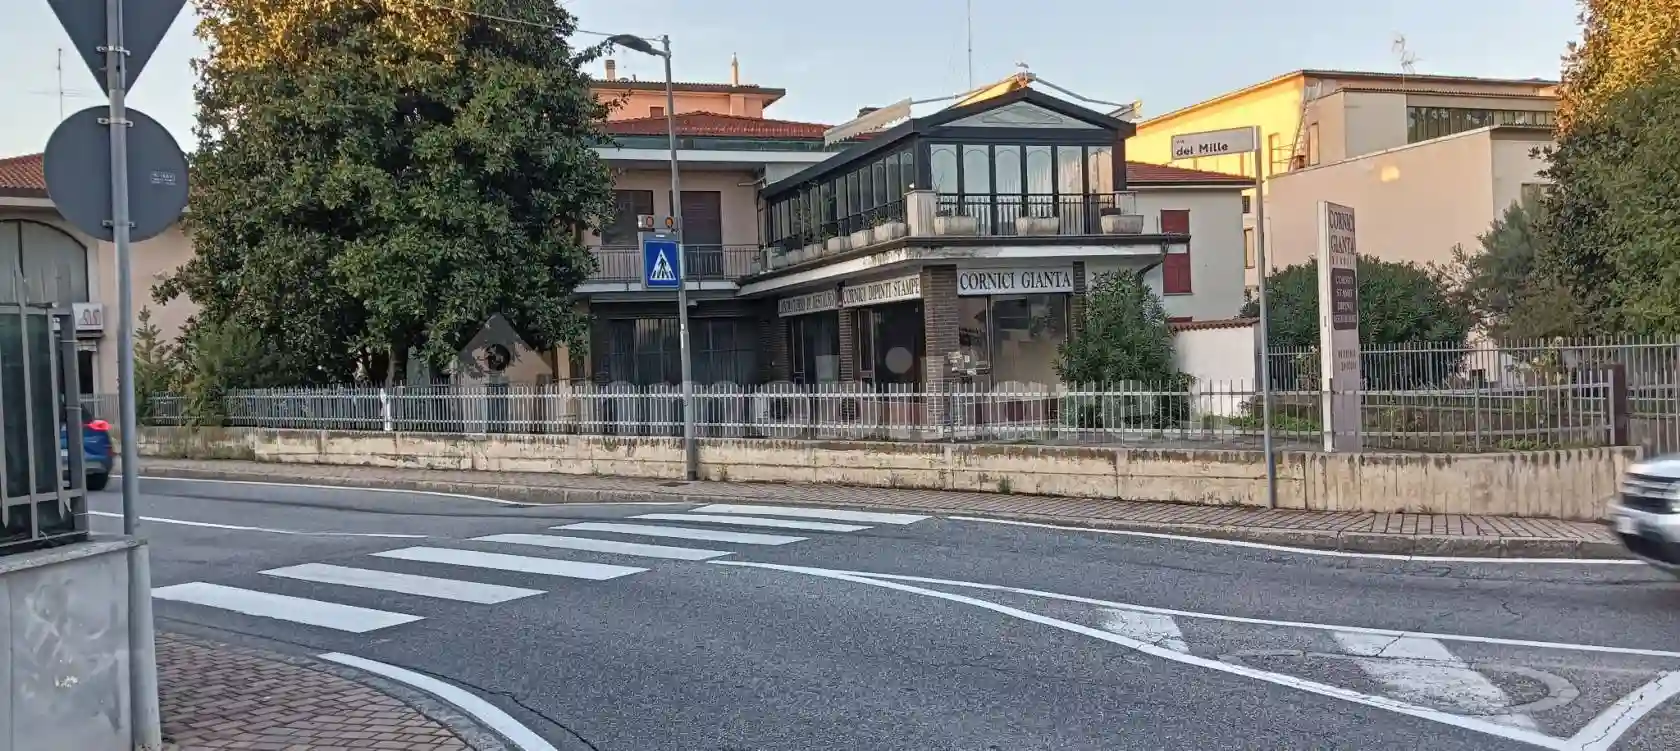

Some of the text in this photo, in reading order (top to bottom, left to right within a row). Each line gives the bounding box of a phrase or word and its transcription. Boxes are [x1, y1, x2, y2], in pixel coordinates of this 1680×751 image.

[1199, 141, 1229, 153] Mille
[960, 271, 1071, 290] CORNICI GIANTA
[842, 285, 865, 304] CORNICI
[893, 277, 920, 298] STAMPE
